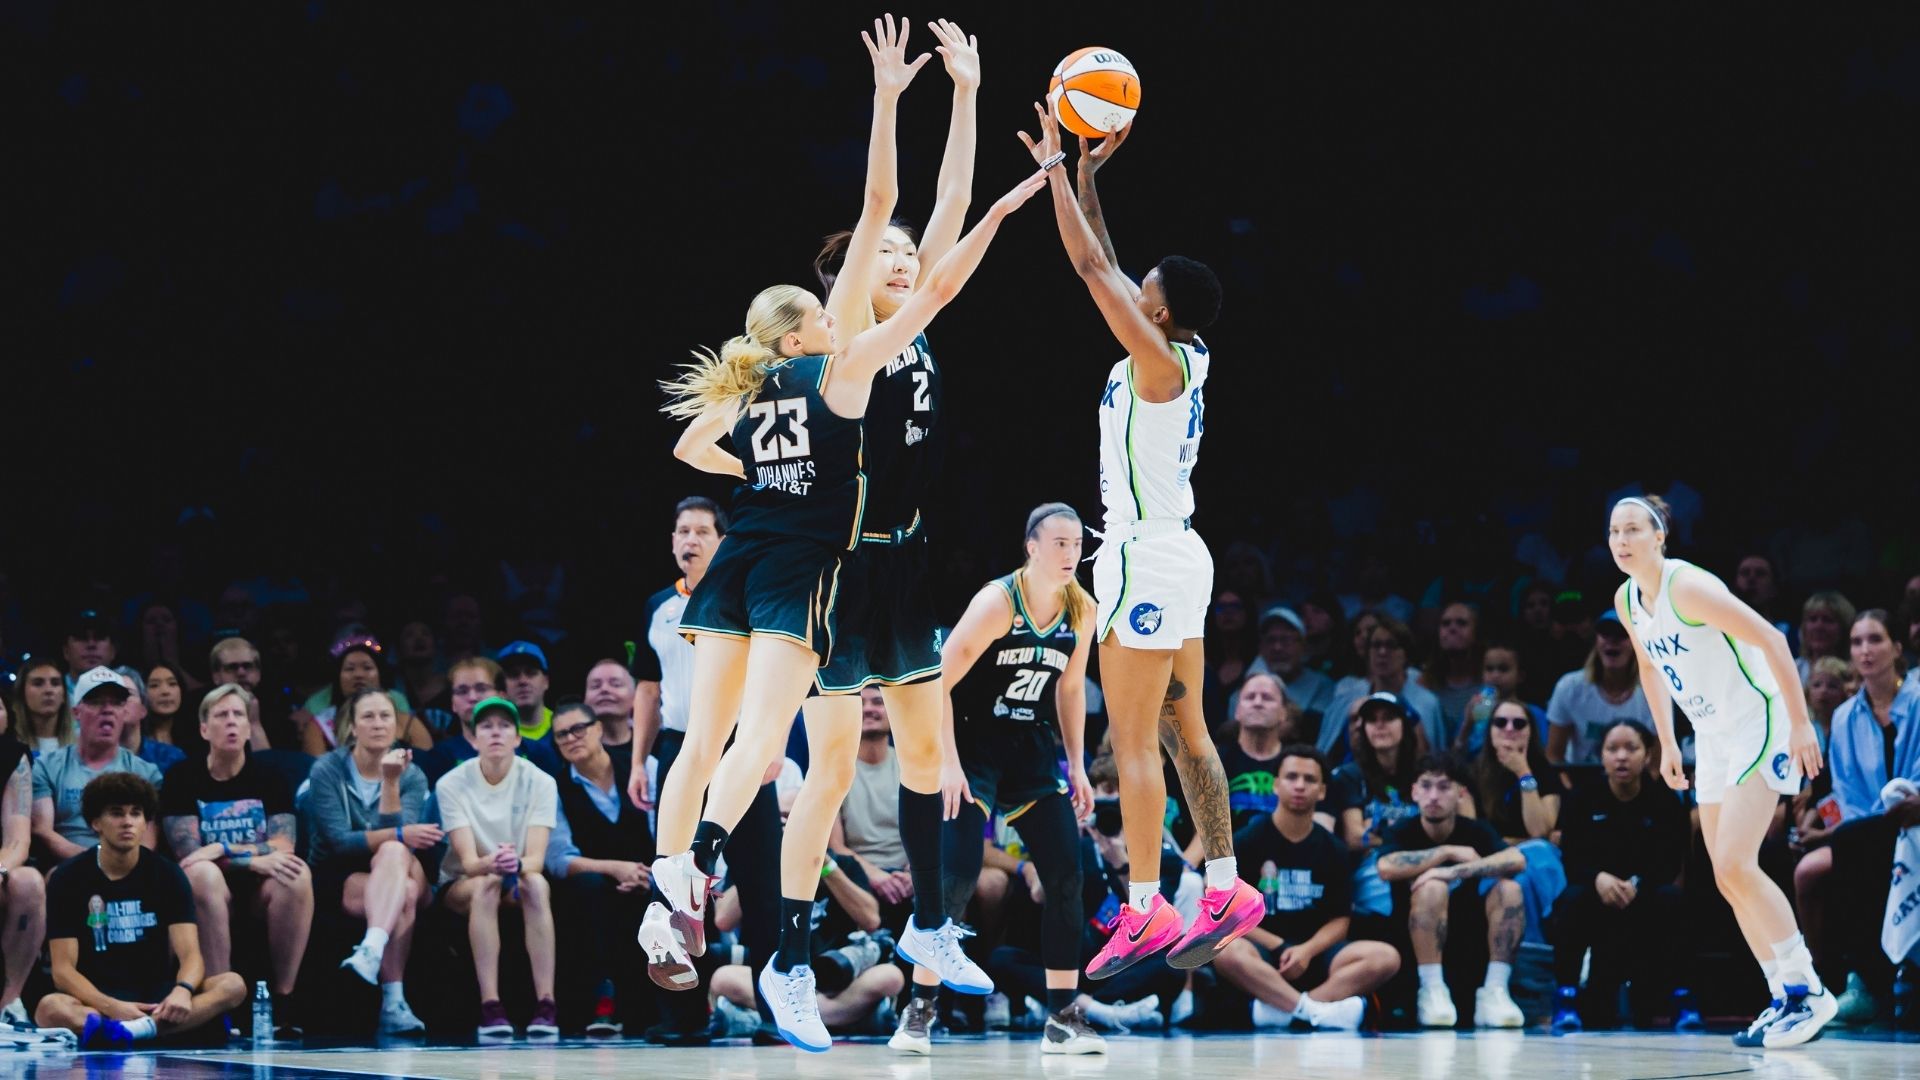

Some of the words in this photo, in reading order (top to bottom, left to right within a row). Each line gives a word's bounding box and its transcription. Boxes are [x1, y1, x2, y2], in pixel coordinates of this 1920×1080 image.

[912, 371, 934, 412] 2
[749, 397, 811, 463] 23
[755, 459, 817, 486] JOHANNÈS
[996, 646, 1036, 666] NEW
[1645, 634, 1688, 658] YNX
[1005, 669, 1051, 701] 20
[1663, 664, 1683, 692] 8
